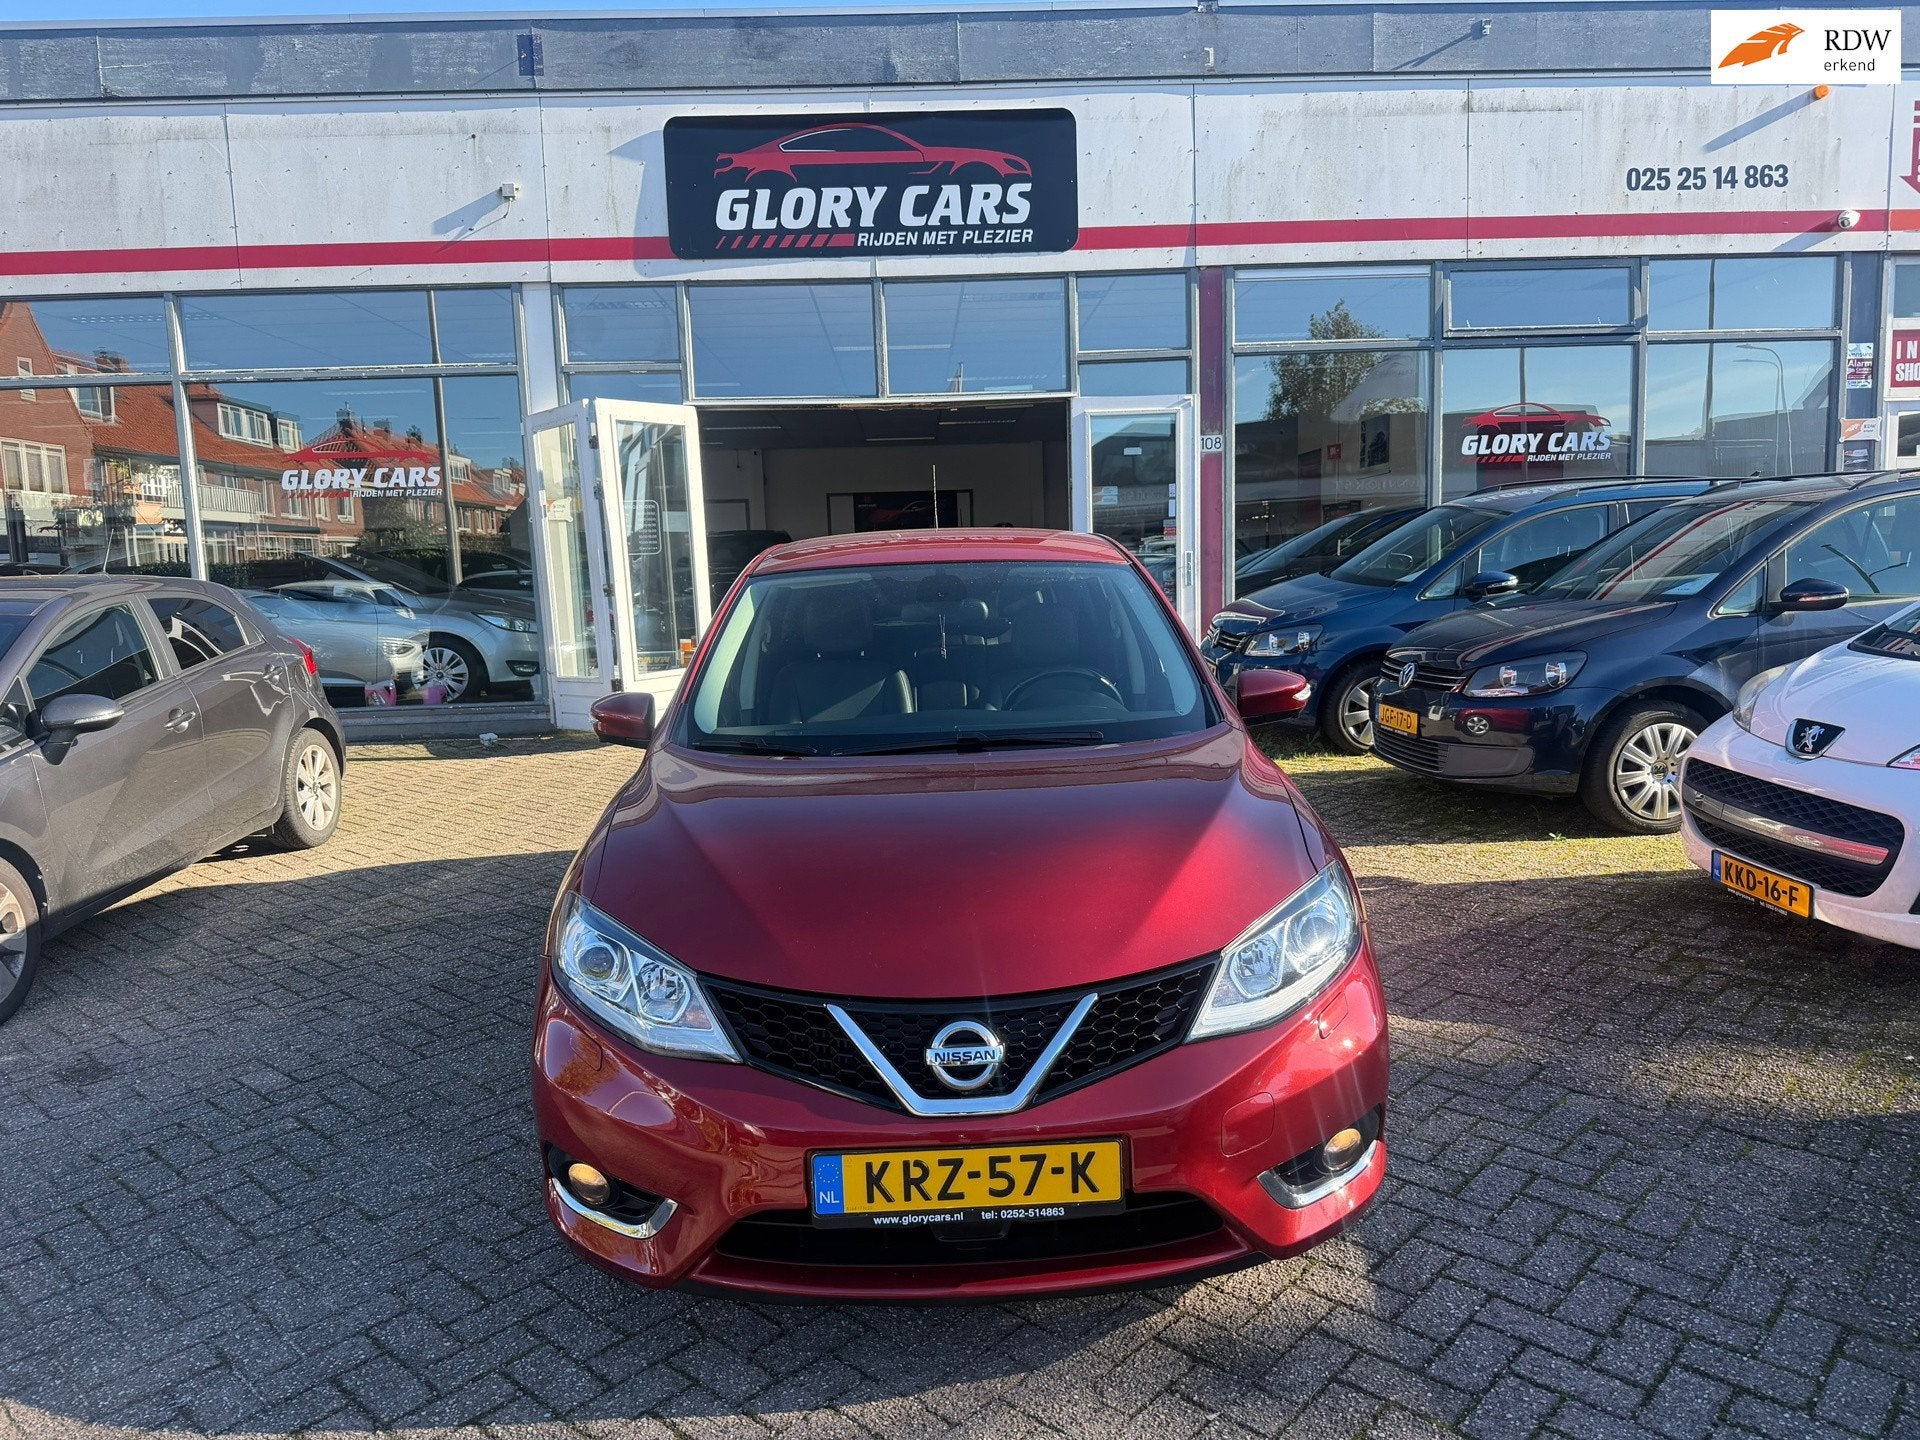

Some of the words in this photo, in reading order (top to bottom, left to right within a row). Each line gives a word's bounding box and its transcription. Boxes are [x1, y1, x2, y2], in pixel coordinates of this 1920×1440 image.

[1626, 167, 1671, 191] 025
[1677, 167, 1707, 191] 25
[1712, 165, 1739, 189] 14
[1744, 164, 1789, 188] 863
[715, 186, 888, 231] GLORY
[899, 183, 1033, 227] CARS
[857, 232, 919, 247] RIJDEN
[922, 230, 958, 245] MET
[962, 229, 1034, 244] PLEZIER
[1847, 359, 1873, 368] Alarm
[1200, 436, 1222, 450] 108
[1461, 432, 1544, 456] GLORY
[1547, 431, 1611, 453] CARS
[1527, 453, 1558, 462] RIJDEN
[1558, 453, 1575, 461] MET
[1577, 452, 1612, 460] PLEZIER
[281, 468, 368, 491] GLORY
[373, 467, 441, 488] CARS
[352, 489, 384, 498] RIJDEN
[385, 489, 405, 497] MET
[406, 488, 443, 497] PLEZIER
[1380, 706, 1412, 730] JGF-17-D
[1724, 860, 1799, 907] KKD-16-F
[934, 1049, 996, 1063] NISSAN
[865, 1151, 1100, 1204] KRZ-57-K
[819, 1190, 840, 1204] NL
[873, 1211, 964, 1225] www.glorycars.nl
[981, 1210, 998, 1220] tel:
[1000, 1207, 1065, 1219] 0252-514863
